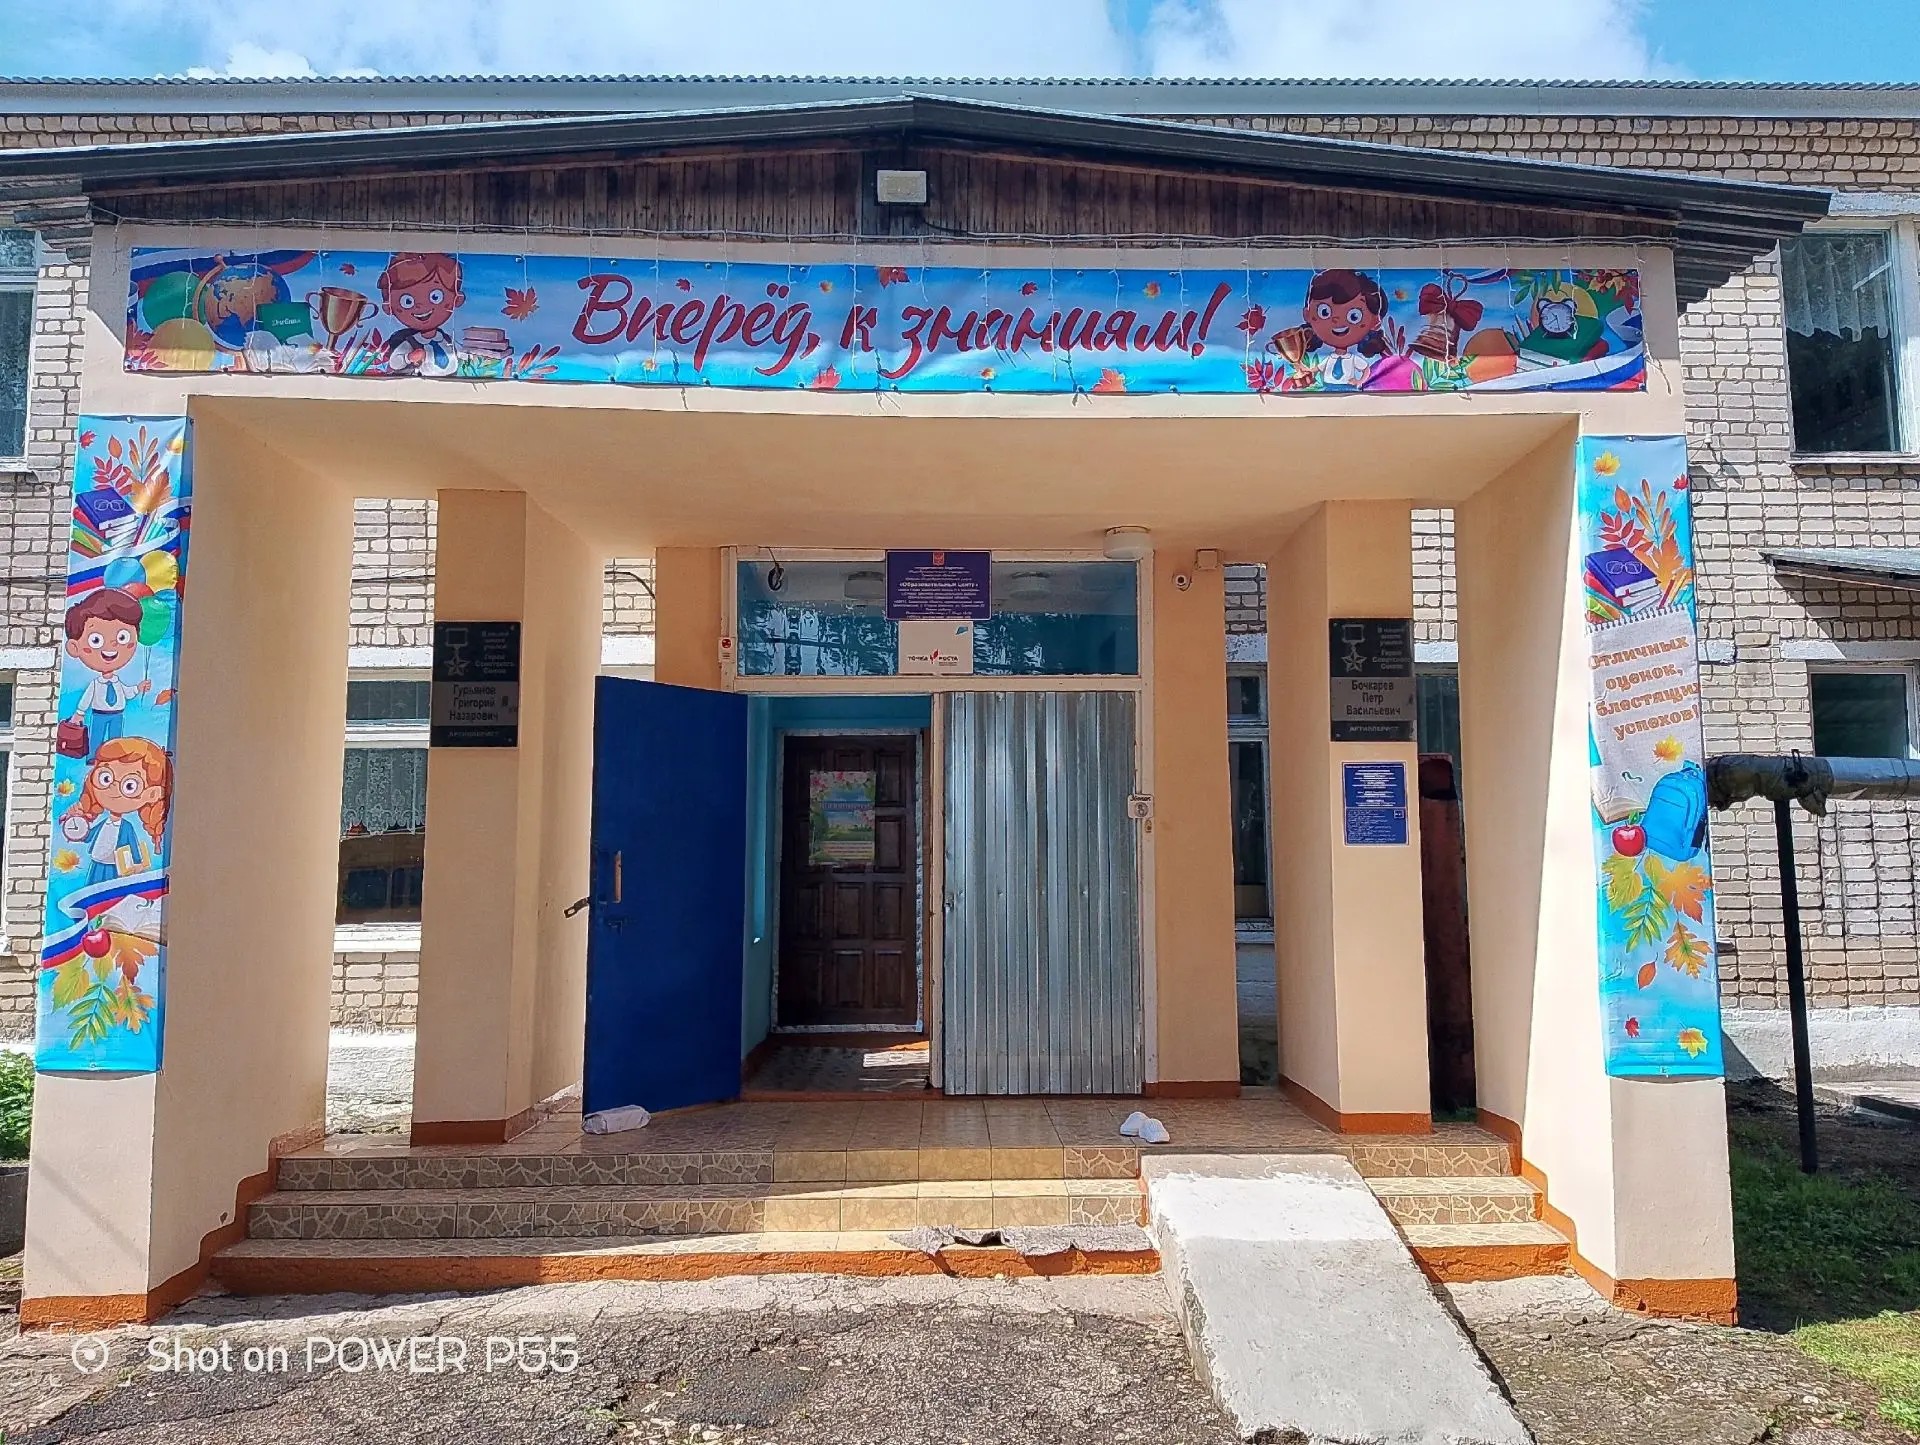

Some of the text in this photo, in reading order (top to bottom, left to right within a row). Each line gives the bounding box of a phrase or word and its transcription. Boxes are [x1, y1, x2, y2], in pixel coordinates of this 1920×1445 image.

[572, 273, 820, 376] Вперёд,
[877, 281, 1232, 379] знаниям!
[1605, 663, 1684, 691] оценок,
[453, 696, 496, 709] Григорий
[1362, 692, 1384, 705] Петр
[449, 709, 499, 722] Назарович
[1346, 704, 1401, 716] Васильевич
[1613, 703, 1700, 742] успехов!
